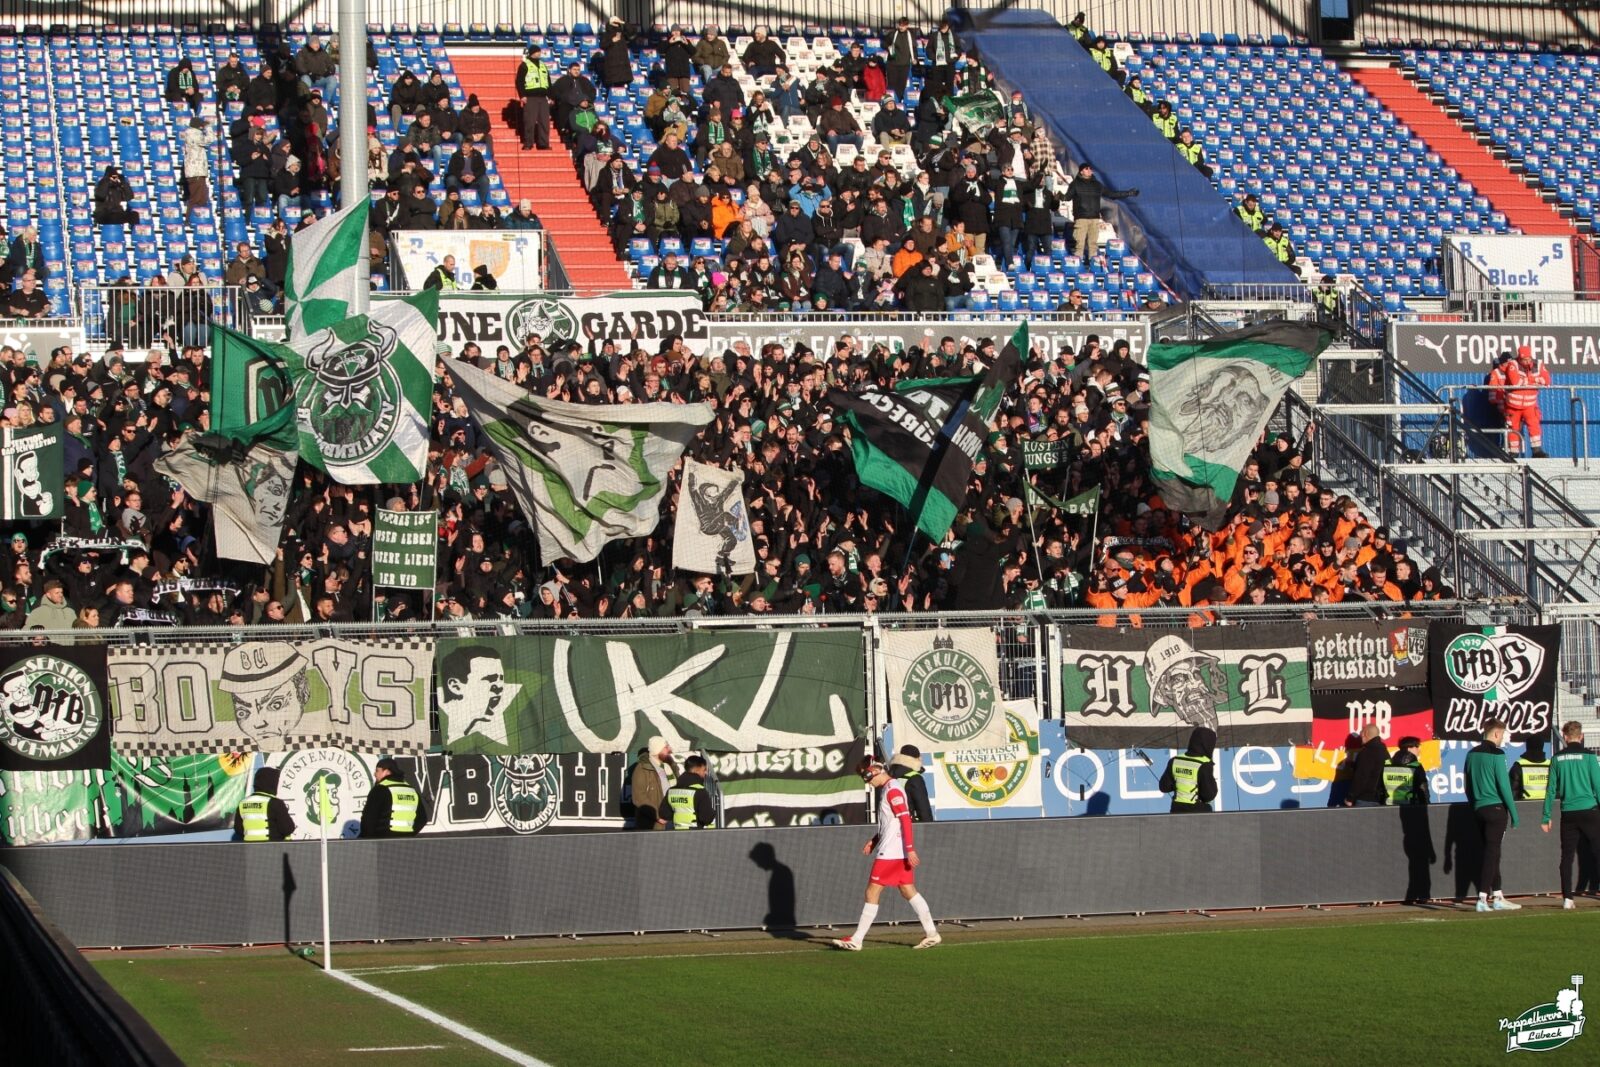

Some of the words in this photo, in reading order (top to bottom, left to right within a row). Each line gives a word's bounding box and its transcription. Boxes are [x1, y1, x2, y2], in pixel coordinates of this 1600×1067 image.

[1459, 242, 1473, 258] R
[1552, 243, 1563, 260] S
[1488, 269, 1539, 287] Block
[582, 308, 709, 341] GARDE
[1571, 335, 1600, 365] FA
[405, 554, 435, 567] LIEBE
[1160, 644, 1182, 661] 1919
[1460, 638, 1482, 648] 1919
[25, 657, 97, 697] SEKTION
[911, 652, 983, 685] SUBKULTUR
[1313, 653, 1397, 681] neustadt
[1451, 647, 1497, 681] VfB
[928, 681, 968, 712] VfB
[947, 716, 980, 738] YOUTH
[1346, 699, 1392, 741] VfB
[7, 714, 99, 759] SCHWARTAU
[282, 750, 365, 791] KÜSTENJUNGS
[956, 752, 1017, 763] HANSEATEN
[981, 791, 997, 801] 1919
[497, 793, 557, 830] VITALIENBRÜDER
